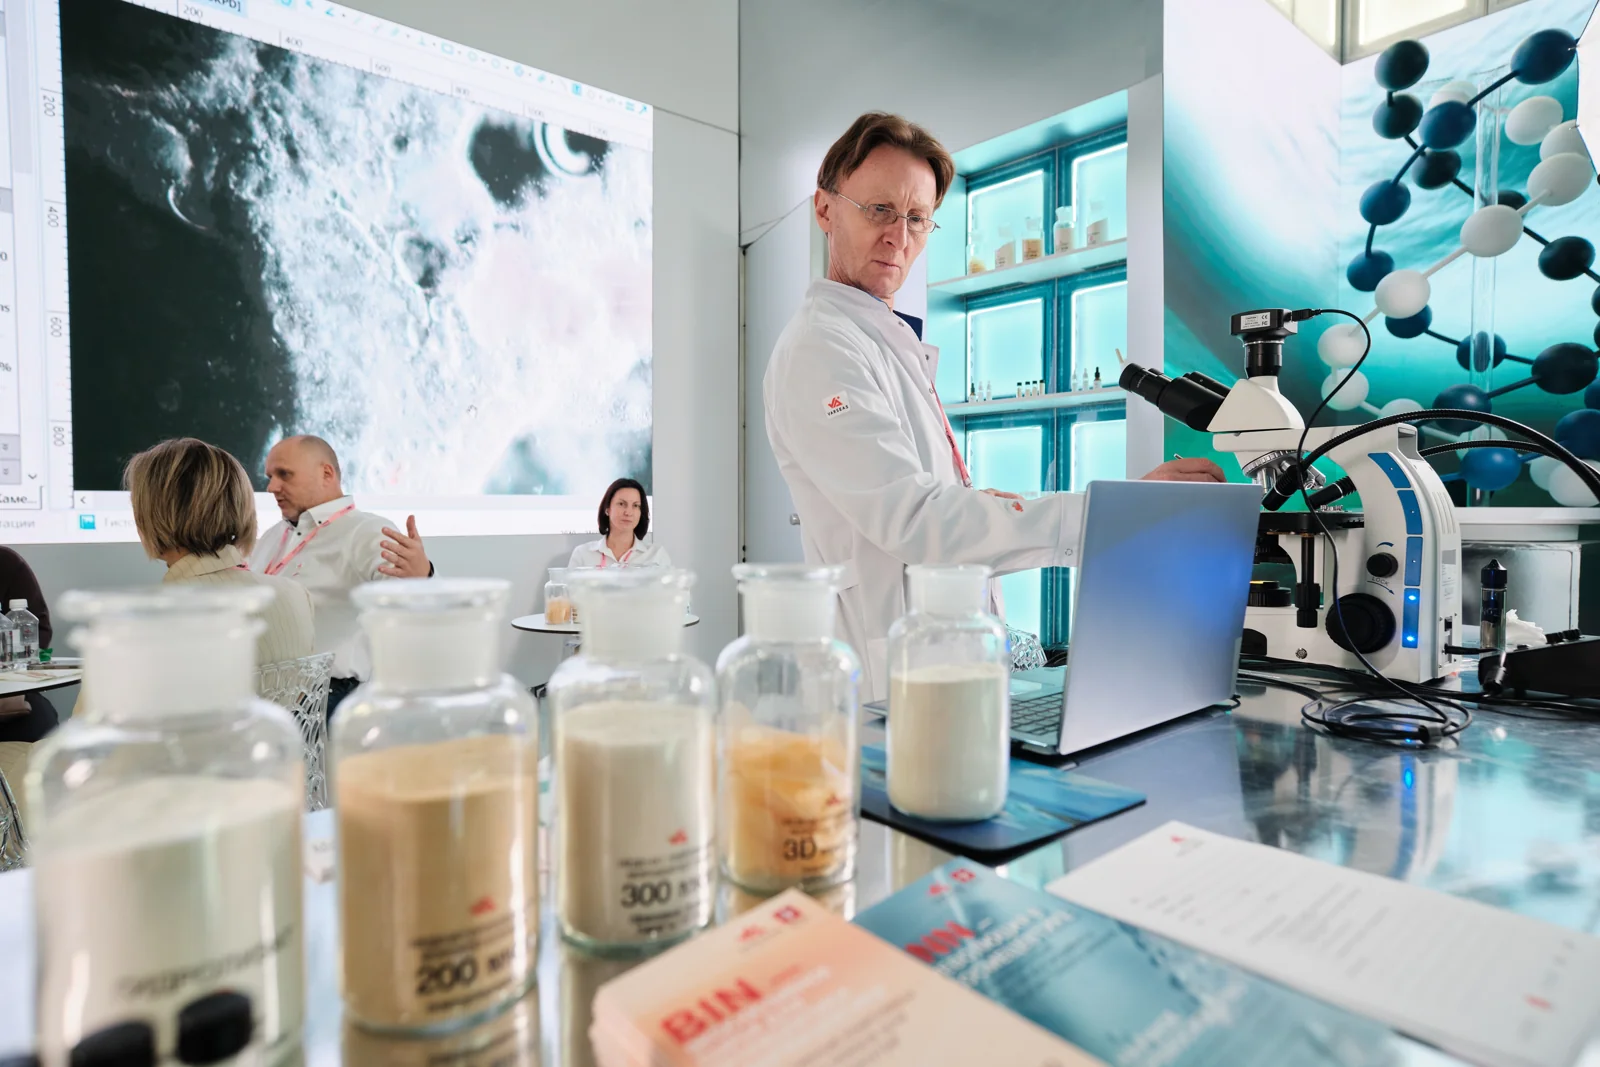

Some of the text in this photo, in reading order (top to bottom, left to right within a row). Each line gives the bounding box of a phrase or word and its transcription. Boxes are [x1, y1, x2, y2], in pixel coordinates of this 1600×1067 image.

[183, 5, 203, 18] 200
[286, 37, 303, 47] 400
[43, 95, 55, 117] 200
[47, 206, 59, 228] 400
[50, 317, 62, 338] 600
[53, 426, 65, 447] 800
[1371, 577, 1390, 586] LOCK
[783, 838, 817, 861] 3D
[620, 880, 671, 909] 300
[415, 954, 479, 995] 200
[660, 978, 762, 1045] BIN
